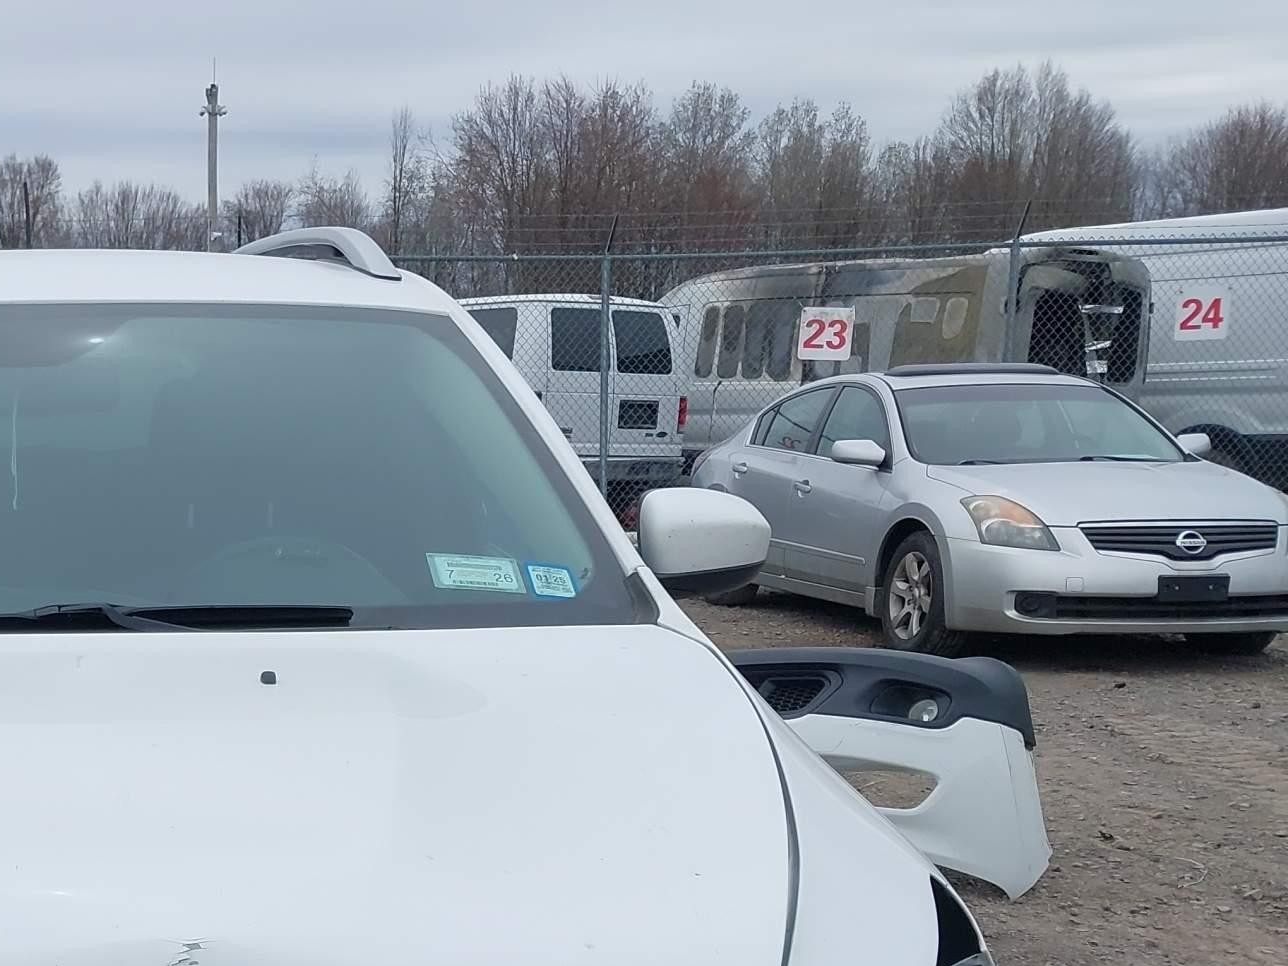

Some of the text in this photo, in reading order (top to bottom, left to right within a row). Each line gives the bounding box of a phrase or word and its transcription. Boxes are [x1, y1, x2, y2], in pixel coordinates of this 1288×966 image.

[1180, 298, 1224, 330] 24
[803, 319, 847, 349] 23
[445, 569, 454, 579] 7
[493, 572, 513, 583] 26
